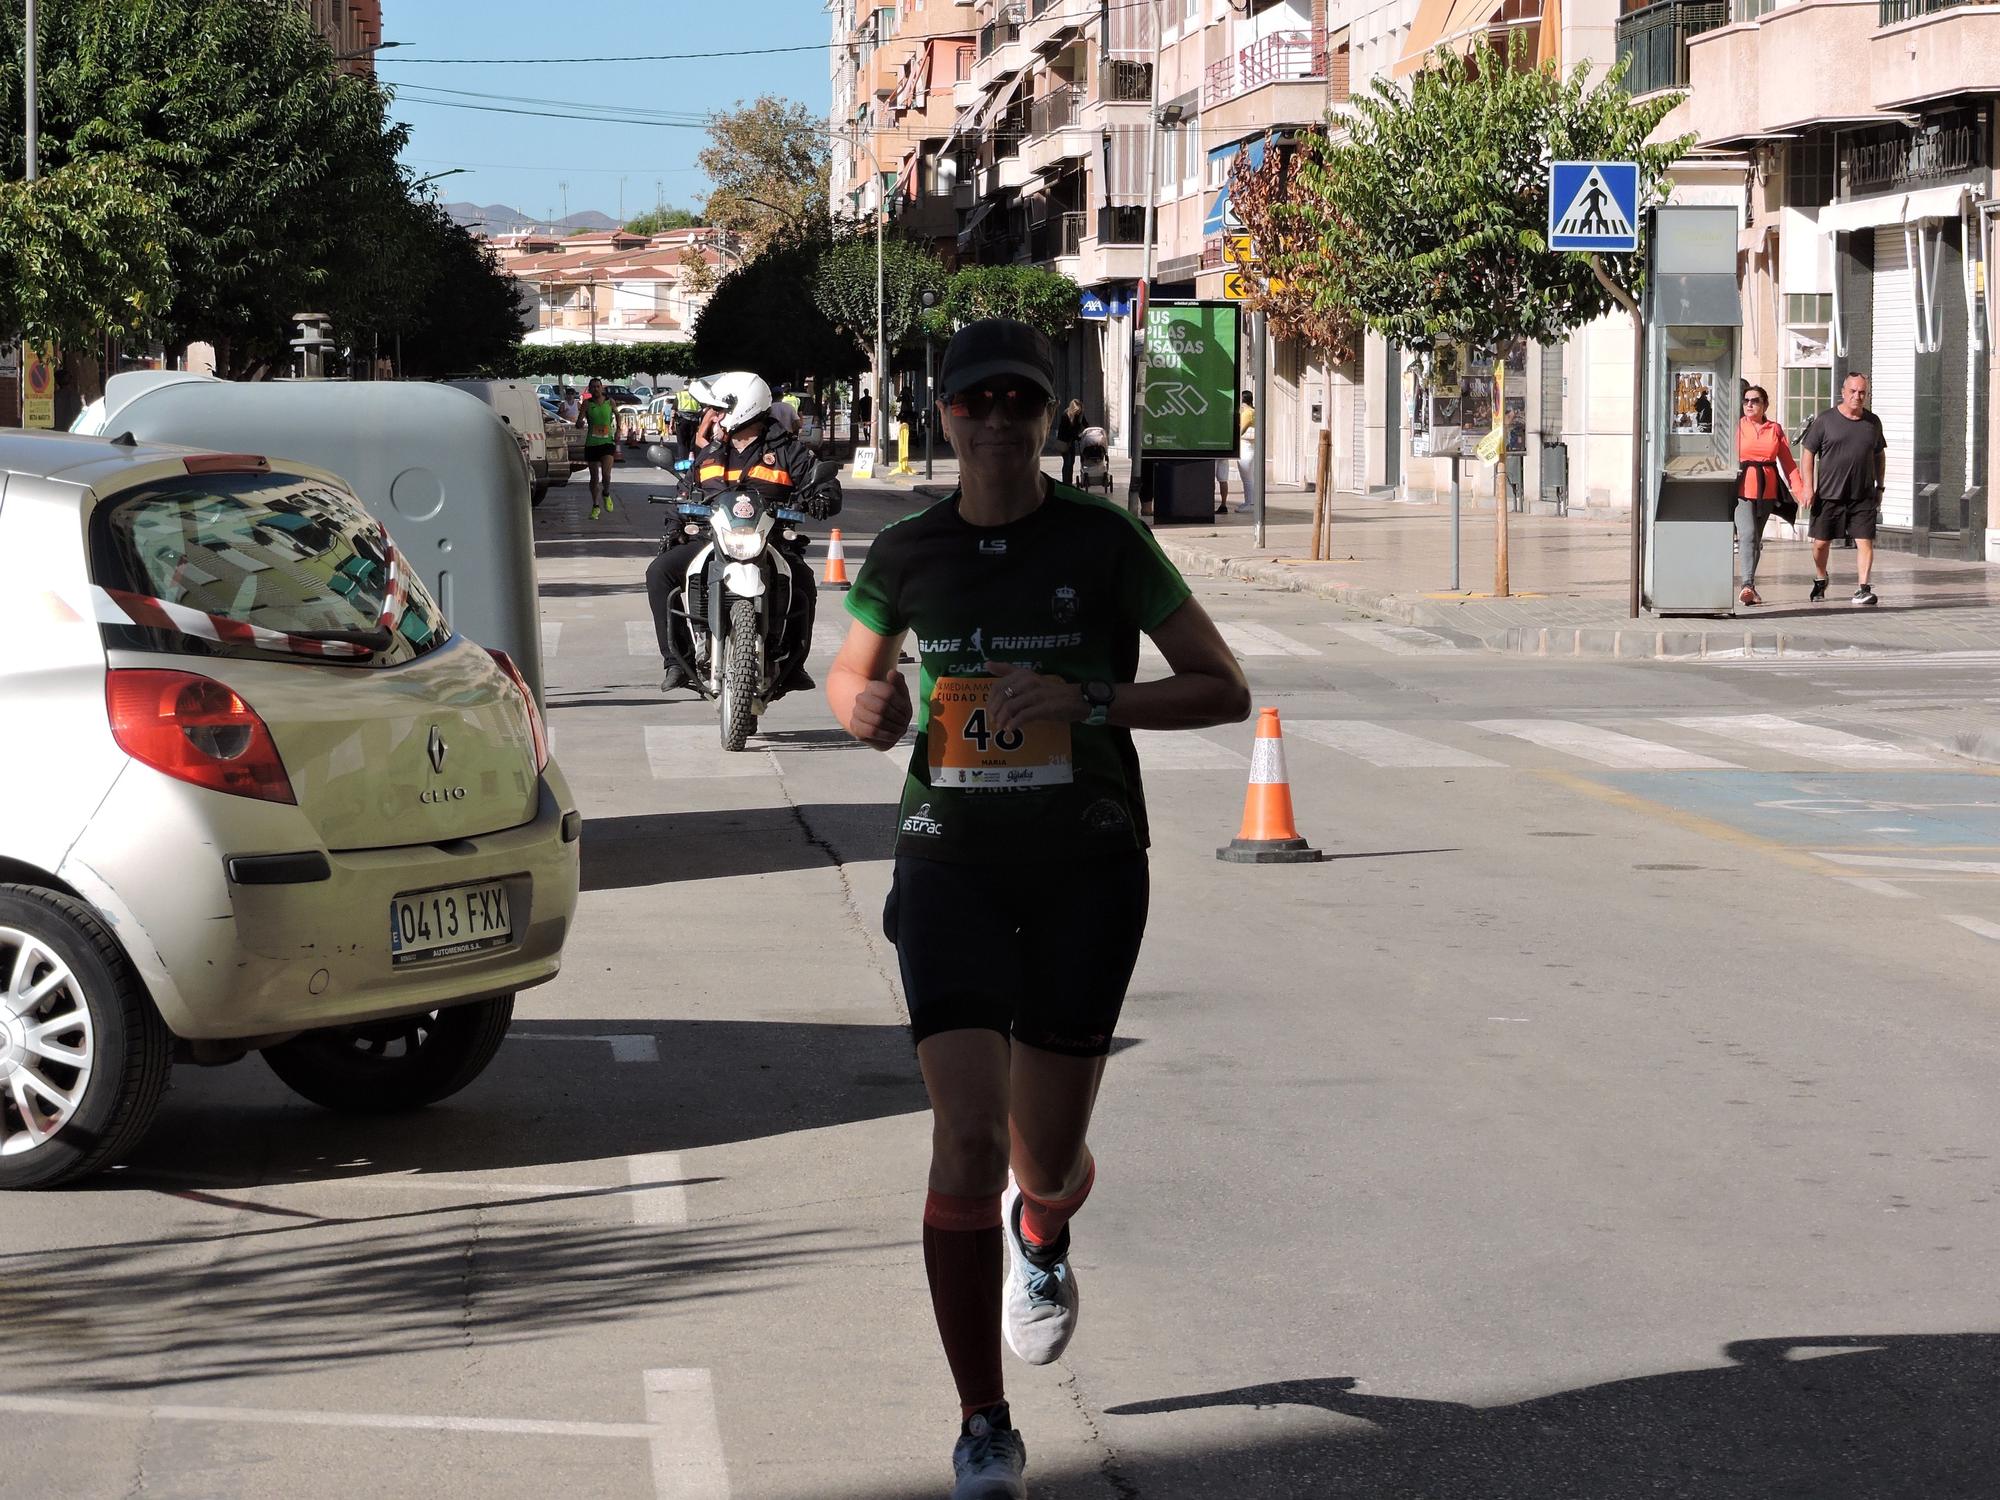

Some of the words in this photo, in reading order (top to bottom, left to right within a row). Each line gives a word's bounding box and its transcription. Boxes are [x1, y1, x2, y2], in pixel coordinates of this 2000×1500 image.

[1082, 300, 1103, 312] AXA
[1148, 311, 1170, 325] US
[858, 449, 874, 459] Km
[860, 459, 867, 470] 2
[991, 632, 1083, 650] RUNNERS
[944, 682, 970, 692] MEDIA
[937, 692, 977, 702] CIUDAD
[420, 786, 467, 804] CLIO
[401, 896, 459, 944] 0413
[466, 888, 506, 933] FXX
[393, 931, 399, 943] E
